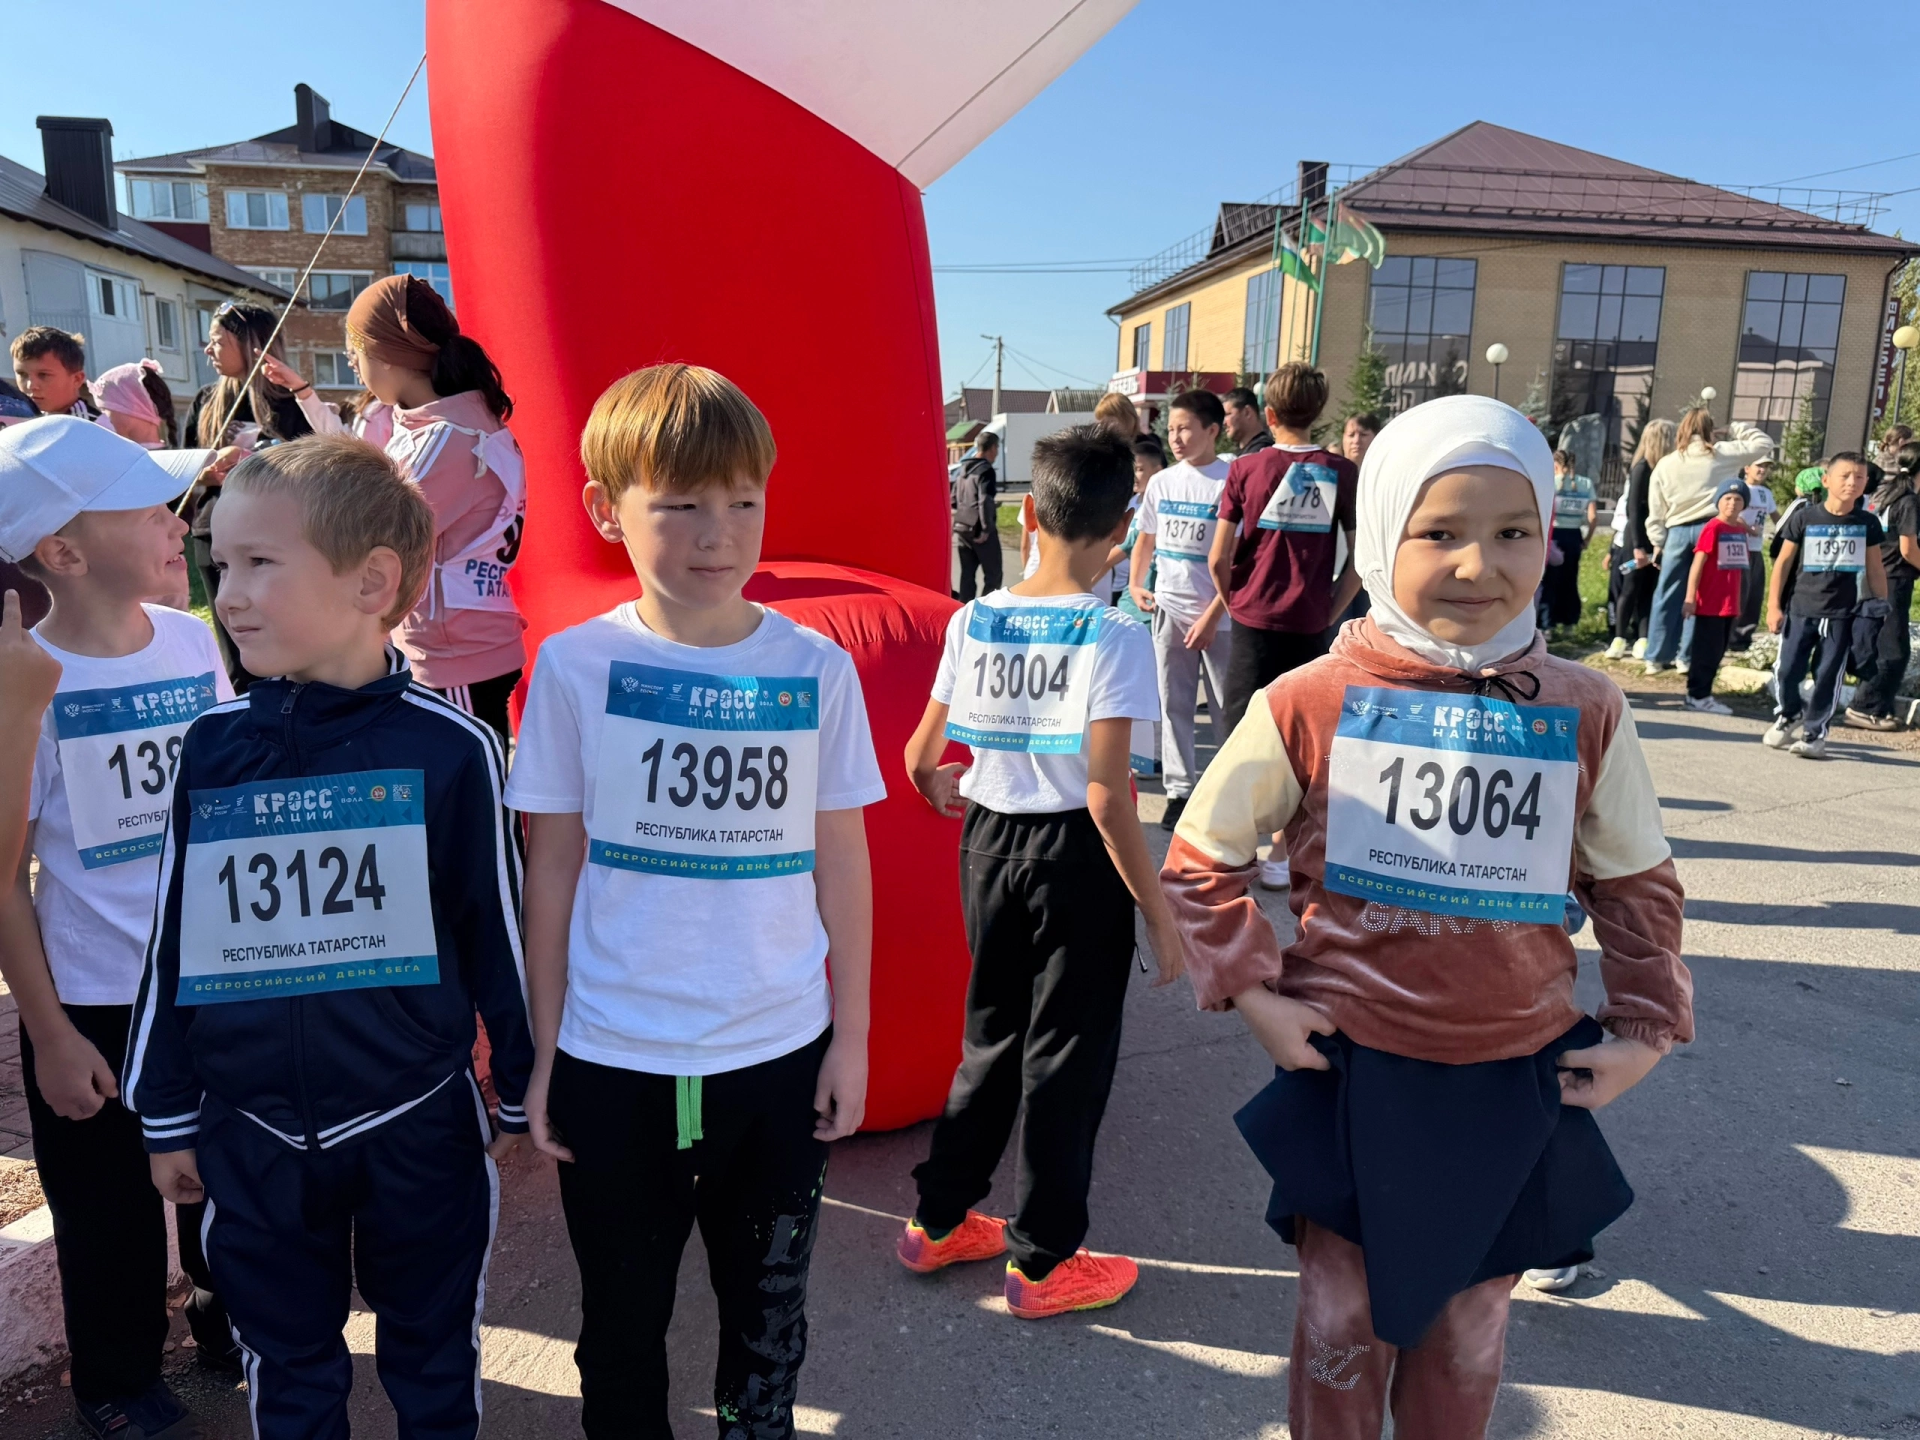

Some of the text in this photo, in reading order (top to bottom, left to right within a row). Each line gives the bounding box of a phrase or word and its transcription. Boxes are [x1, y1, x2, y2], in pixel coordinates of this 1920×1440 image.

[1165, 519, 1206, 541] 13718
[1815, 539, 1856, 555] 13970
[1003, 629, 1048, 637] НАЦИИ
[1004, 615, 1050, 630] КРОСС
[973, 652, 1070, 702] 13004
[132, 686, 197, 712] КРОСС
[689, 686, 755, 709] КРОСС
[137, 703, 199, 720] НАЦИИ
[688, 707, 756, 720] НАЦИИ
[968, 712, 1061, 727] РЕСПУБЛИКА ТАТАРСТАН
[1434, 705, 1505, 732] КРОСС
[951, 729, 1024, 744] ВСЕРОССИЙСКИЙ
[1433, 728, 1506, 743] НАЦИИ
[641, 737, 788, 811] 13958
[253, 788, 333, 814] КРОСС
[1378, 756, 1542, 841] 13064
[255, 810, 333, 826] НАЦИИ
[635, 821, 783, 843] РЕСПУБЛИКА ТАТАРСТАН
[604, 849, 803, 872] ВСЕРОССИЙСКИЙ ДЕНЬ БЕГА
[1368, 848, 1527, 882] РЕСПУБЛИКА ТАТАРСТАН
[218, 843, 386, 924] 13124
[1338, 873, 1549, 910] ВСЕРОССИЙСКИЙ ДЕНЬ БЕГА
[222, 934, 386, 962] РЕСПУБЛИКА ТАТАРСТАН
[195, 964, 420, 991] ВСЕРОССИЙСКИЙ ДЕНЬ БЕГА
